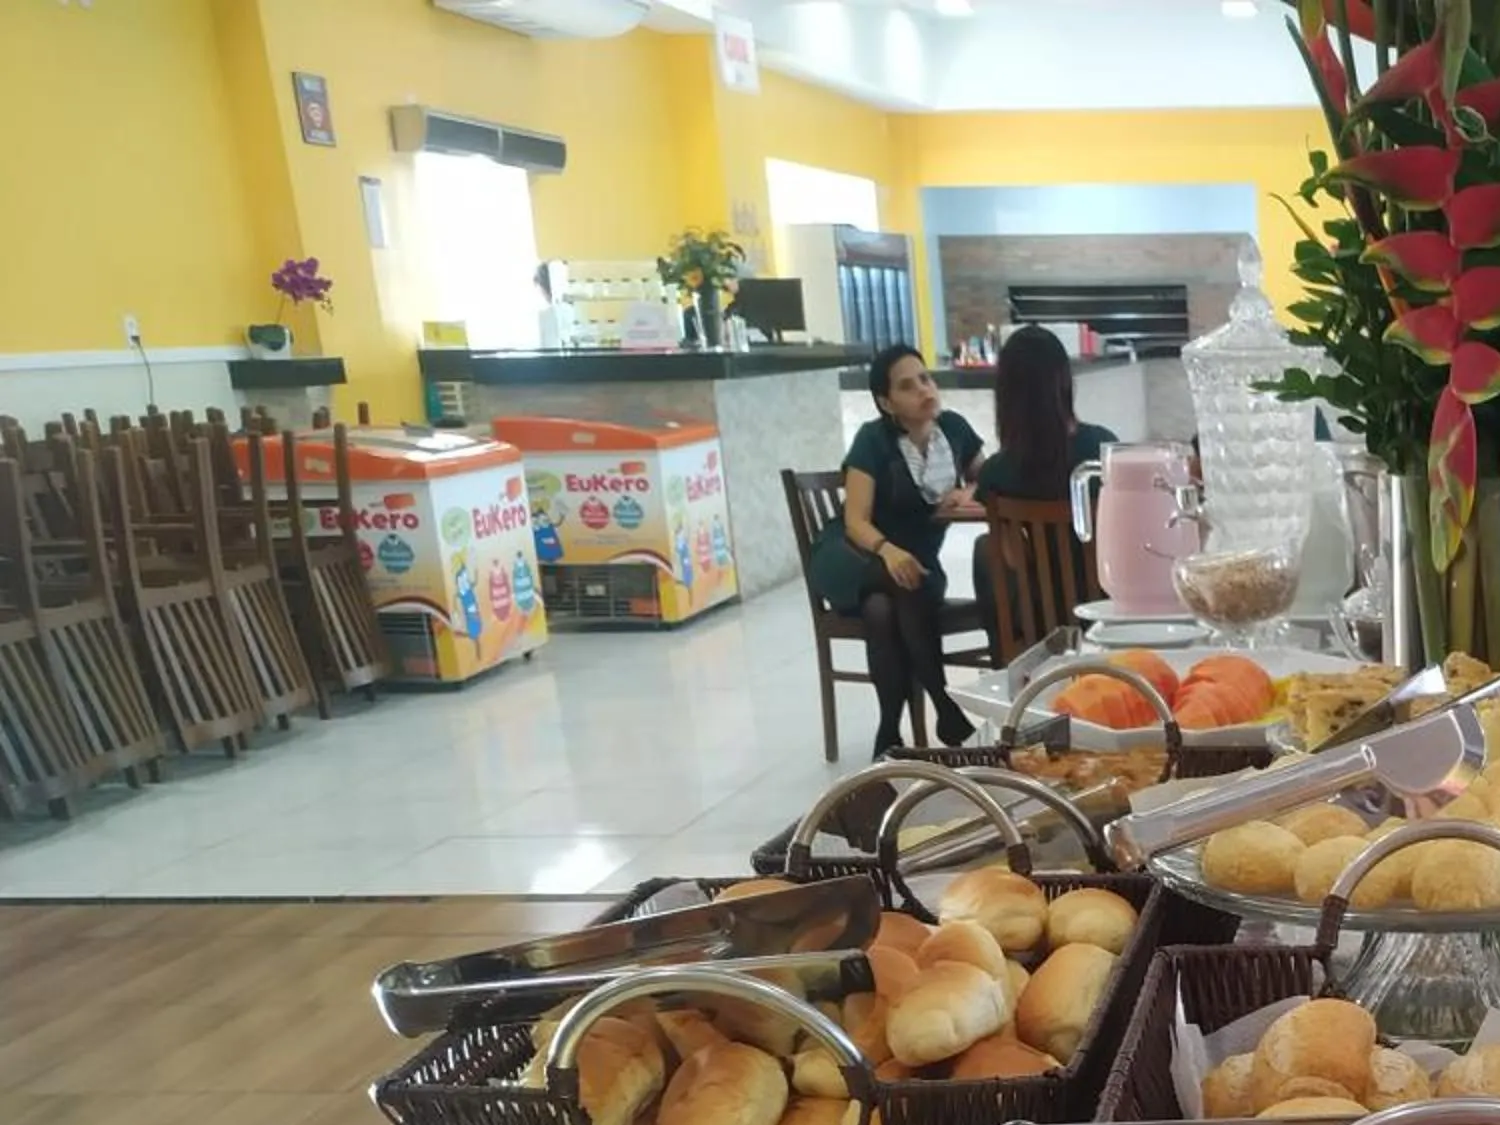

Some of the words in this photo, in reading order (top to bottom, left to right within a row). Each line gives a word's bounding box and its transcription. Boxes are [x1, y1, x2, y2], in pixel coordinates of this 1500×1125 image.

[565, 473, 650, 493] EuKero
[319, 506, 419, 531] EKero
[472, 502, 527, 539] EuKero
